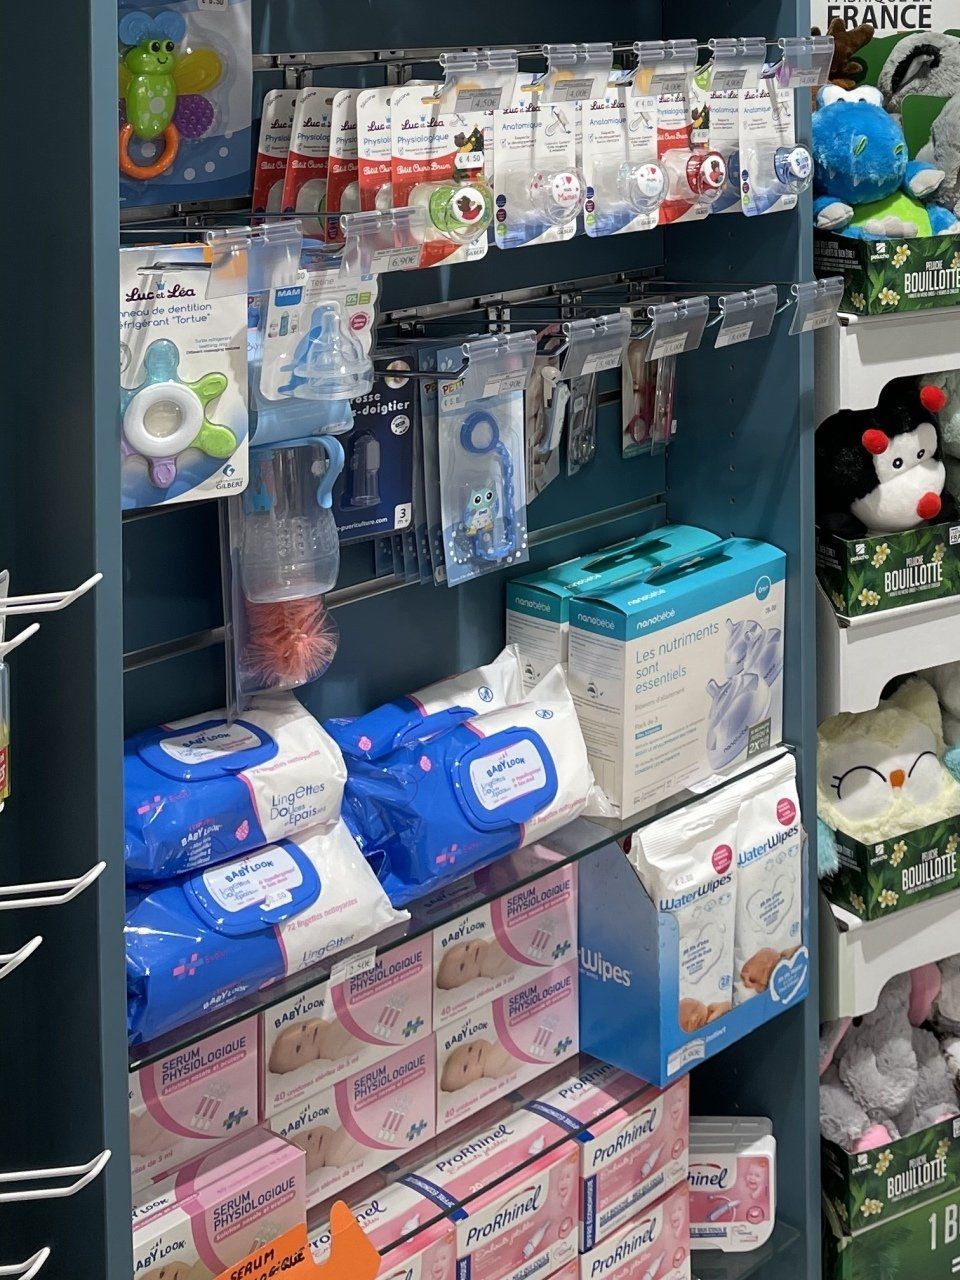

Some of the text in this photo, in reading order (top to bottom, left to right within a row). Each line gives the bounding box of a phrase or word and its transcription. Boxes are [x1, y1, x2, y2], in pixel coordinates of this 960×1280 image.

[827, 4, 932, 30] FRANCE
[397, 133, 450, 145] Physiologique
[402, 120, 419, 131] Luc
[126, 287, 155, 302] Luc
[167, 284, 196, 298] Léa
[276, 288, 302, 298] MAM
[152, 303, 212, 315] de dentition
[215, 481, 243, 491] GILBERT
[400, 508, 407, 518] 3
[883, 564, 944, 593] BOUILLOTTE
[636, 608, 676, 630] nanobébé
[635, 621, 720, 665] Les nutriments
[635, 661, 660, 678] sont
[635, 665, 688, 695] essentiels
[271, 782, 326, 808] Lingettes
[224, 860, 275, 884] BABY LOOK
[507, 886, 537, 909] SERUM
[507, 879, 571, 918] PHYSIOLOGIQUE
[659, 872, 732, 912] WaterWipes
[441, 920, 486, 949] BABY LOOK
[350, 951, 423, 995] PHYSIOLOGIQUE
[508, 985, 538, 1007] SERUM
[508, 976, 572, 1018] PHYSIOLOGIQUE
[273, 997, 327, 1029] BABY LOOK
[444, 1027, 470, 1050] BABY
[161, 1046, 201, 1075] SERUM
[161, 1036, 247, 1086] PHYSIOLOGIQUE
[353, 1054, 427, 1102] PHYSIOLOGIQUE
[354, 1065, 387, 1090] SERUM
[435, 1123, 515, 1174] ProRhinel
[592, 1107, 658, 1167] ProRhinel
[213, 1176, 296, 1232] PHYSIOLOGIQUE
[213, 1190, 251, 1220] SERUM
[466, 1184, 543, 1248] ProRhinel
[927, 1213, 938, 1251] 1
[159, 1240, 186, 1260] LOOK
[591, 1217, 657, 1278] ProRhinel
